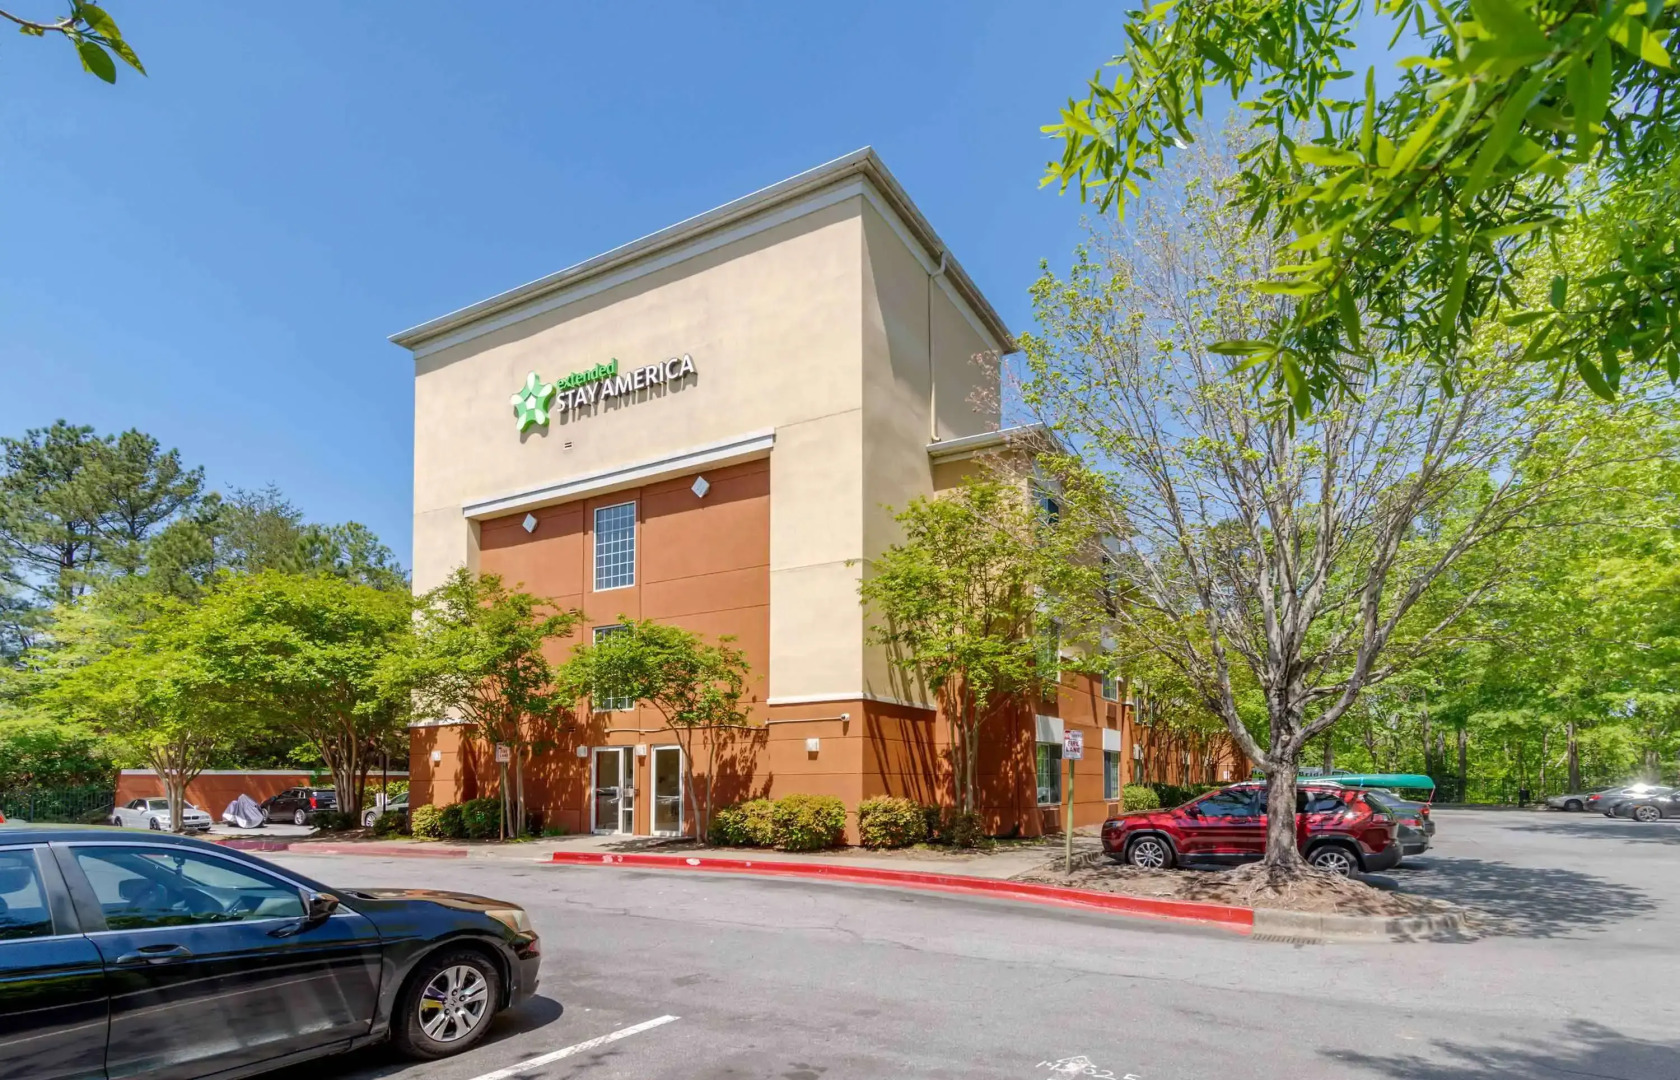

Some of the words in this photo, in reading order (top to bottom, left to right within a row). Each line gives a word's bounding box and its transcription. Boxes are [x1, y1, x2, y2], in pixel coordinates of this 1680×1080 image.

[556, 358, 618, 390] extended
[556, 380, 600, 412] STAY
[601, 353, 696, 401] AMERICA
